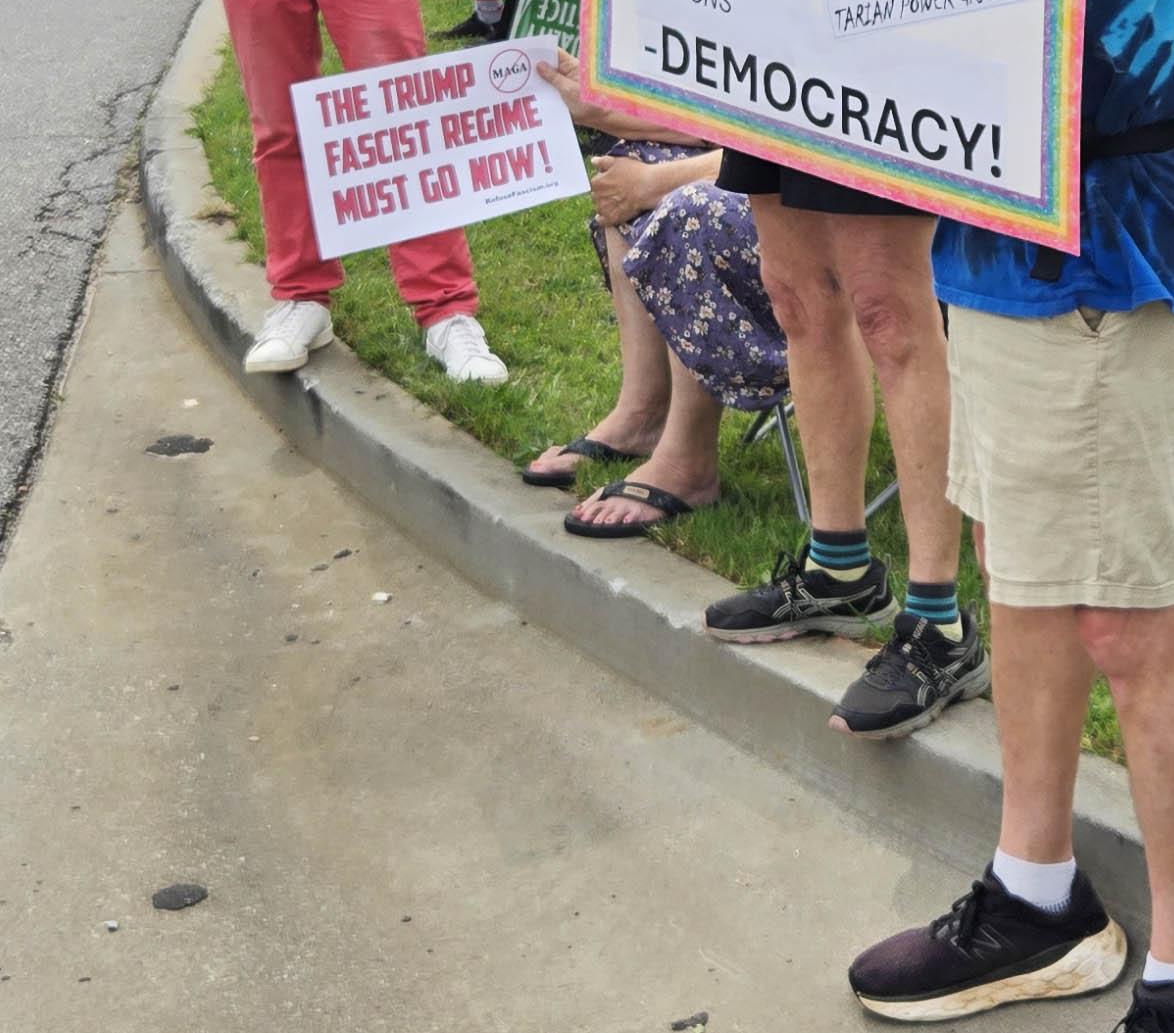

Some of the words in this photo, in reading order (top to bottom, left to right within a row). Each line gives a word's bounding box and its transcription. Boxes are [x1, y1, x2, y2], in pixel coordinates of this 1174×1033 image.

[315, 84, 371, 128] THE
[378, 62, 476, 114] TRUMP
[492, 61, 528, 80] MAGA
[644, 25, 1003, 179] -DEMOCRACY!
[323, 119, 431, 177] FASCIST
[440, 94, 543, 150] REGIME
[332, 174, 409, 226] MUST
[418, 164, 462, 204] GO
[468, 139, 553, 194] NOW!
